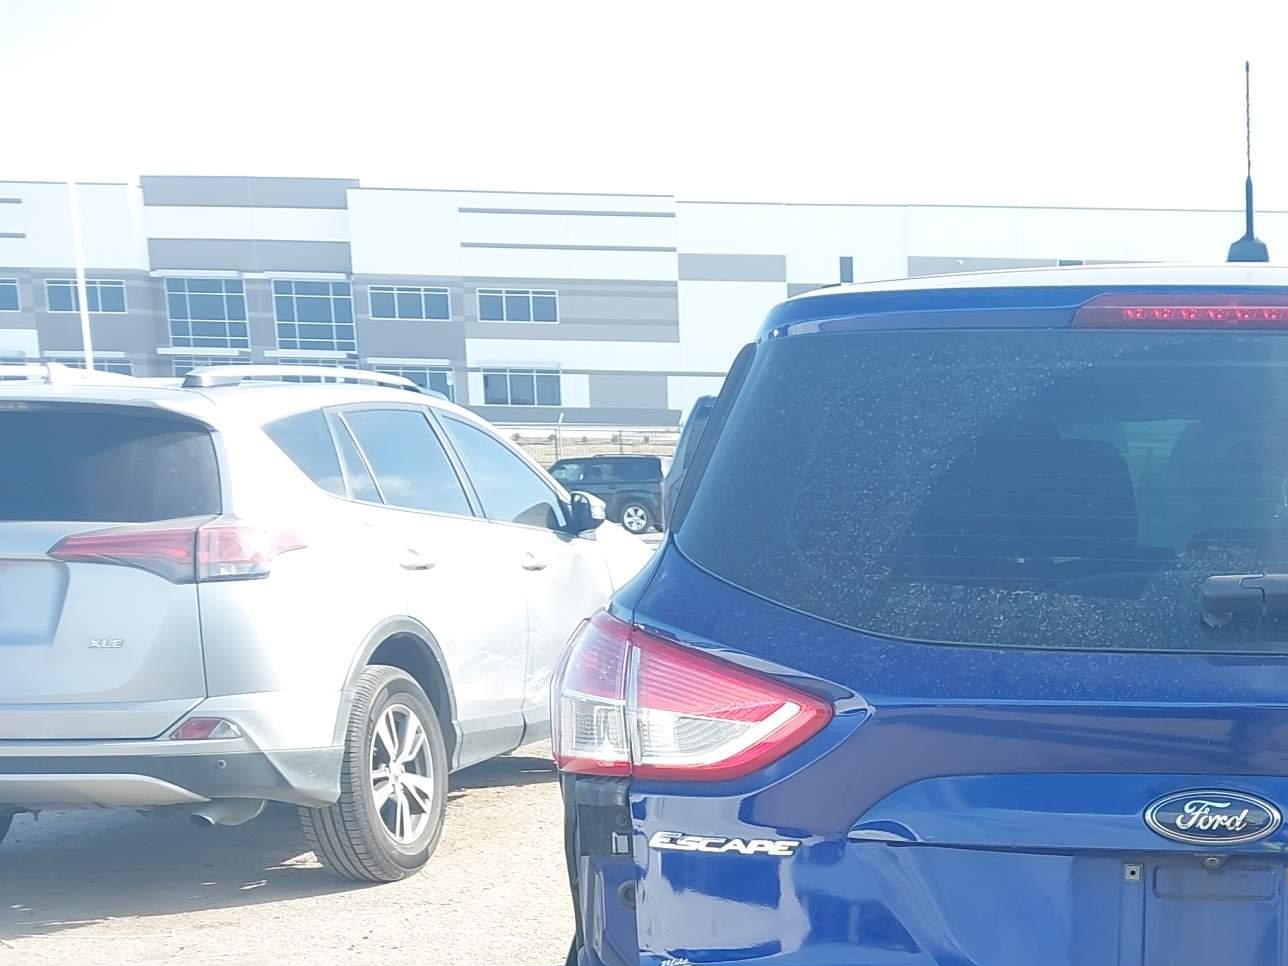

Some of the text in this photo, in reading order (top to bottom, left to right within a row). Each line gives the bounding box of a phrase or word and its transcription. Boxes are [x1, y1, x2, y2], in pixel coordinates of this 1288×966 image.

[90, 639, 122, 648] XLE
[1175, 800, 1249, 831] Ford
[649, 831, 800, 856] ESCAPE
